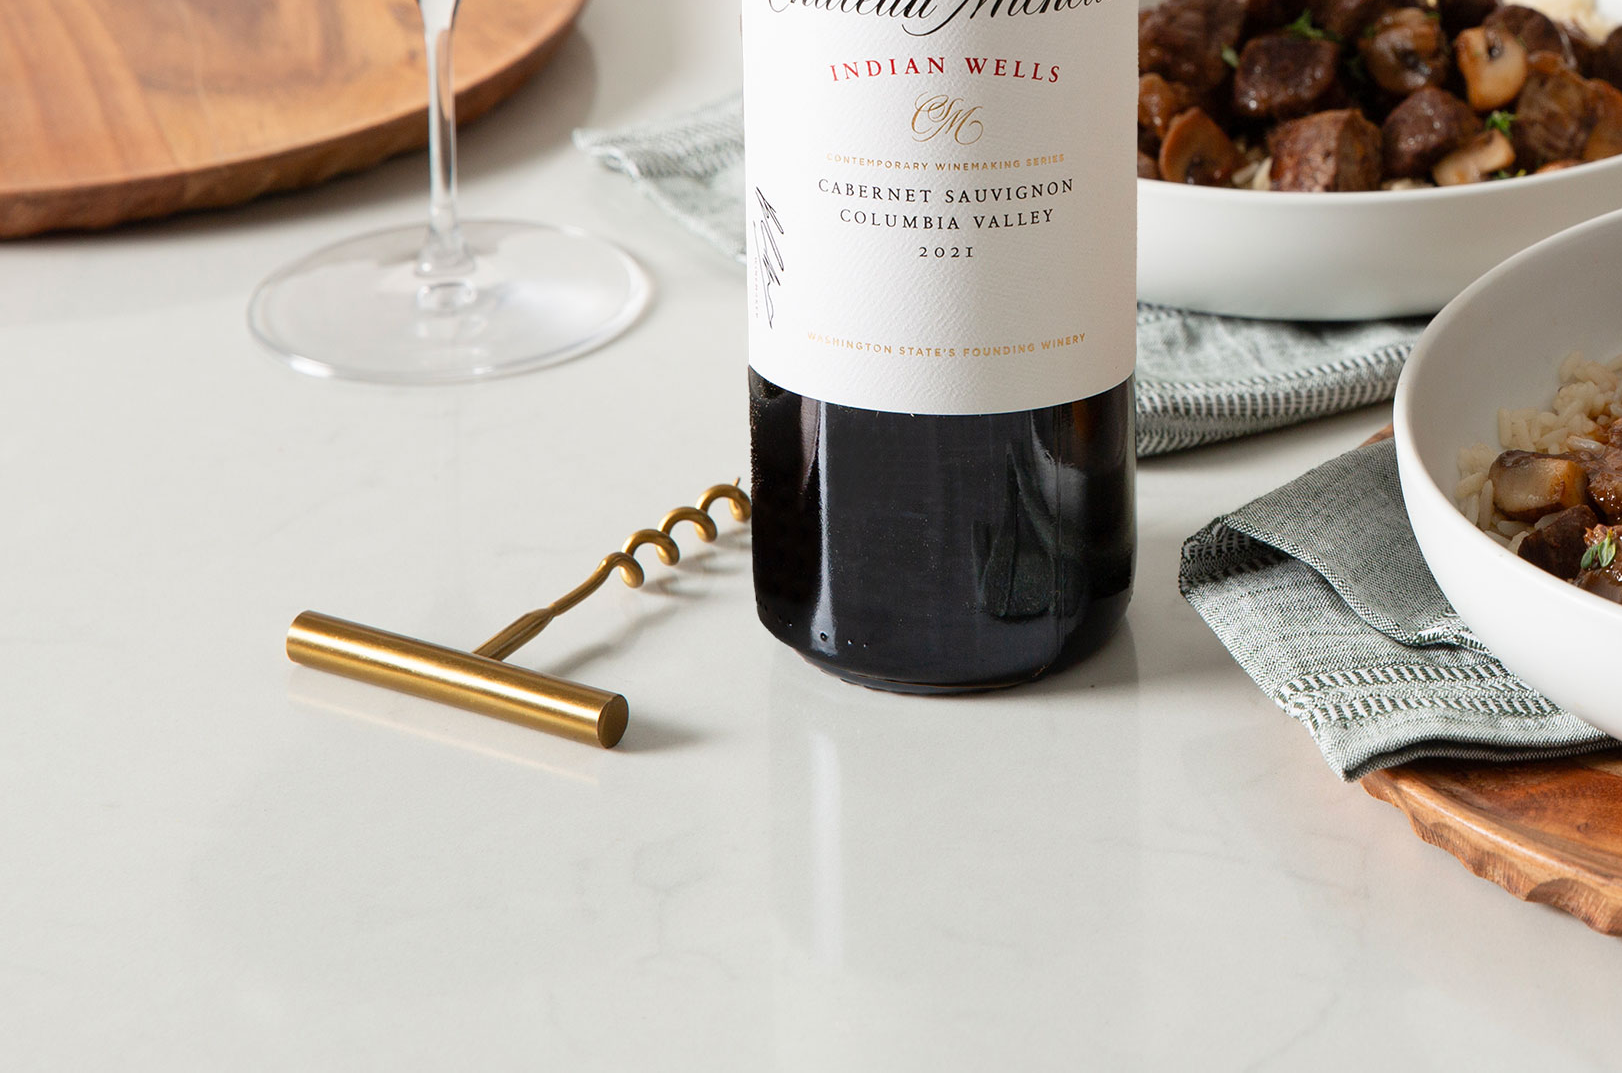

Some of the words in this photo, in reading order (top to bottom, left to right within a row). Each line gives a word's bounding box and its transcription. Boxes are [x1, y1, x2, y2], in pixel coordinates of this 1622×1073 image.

[828, 56, 946, 82] INDIAN
[965, 57, 1062, 84] WELLS
[826, 153, 930, 172] CONTEMPORARY
[934, 159, 1022, 172] WINEMAKING
[1026, 153, 1066, 167] SERIES
[817, 177, 933, 204] CABERNET
[944, 177, 1075, 205] SAUVIGNON
[839, 208, 961, 231] COLUMBIA
[972, 207, 1055, 230] VALLEY
[918, 245, 975, 259] 2021
[806, 330, 893, 355] WASHINGTON
[898, 345, 957, 358] STATE'S
[962, 342, 1036, 358] FOUNDING
[1040, 332, 1087, 351] WINERY
